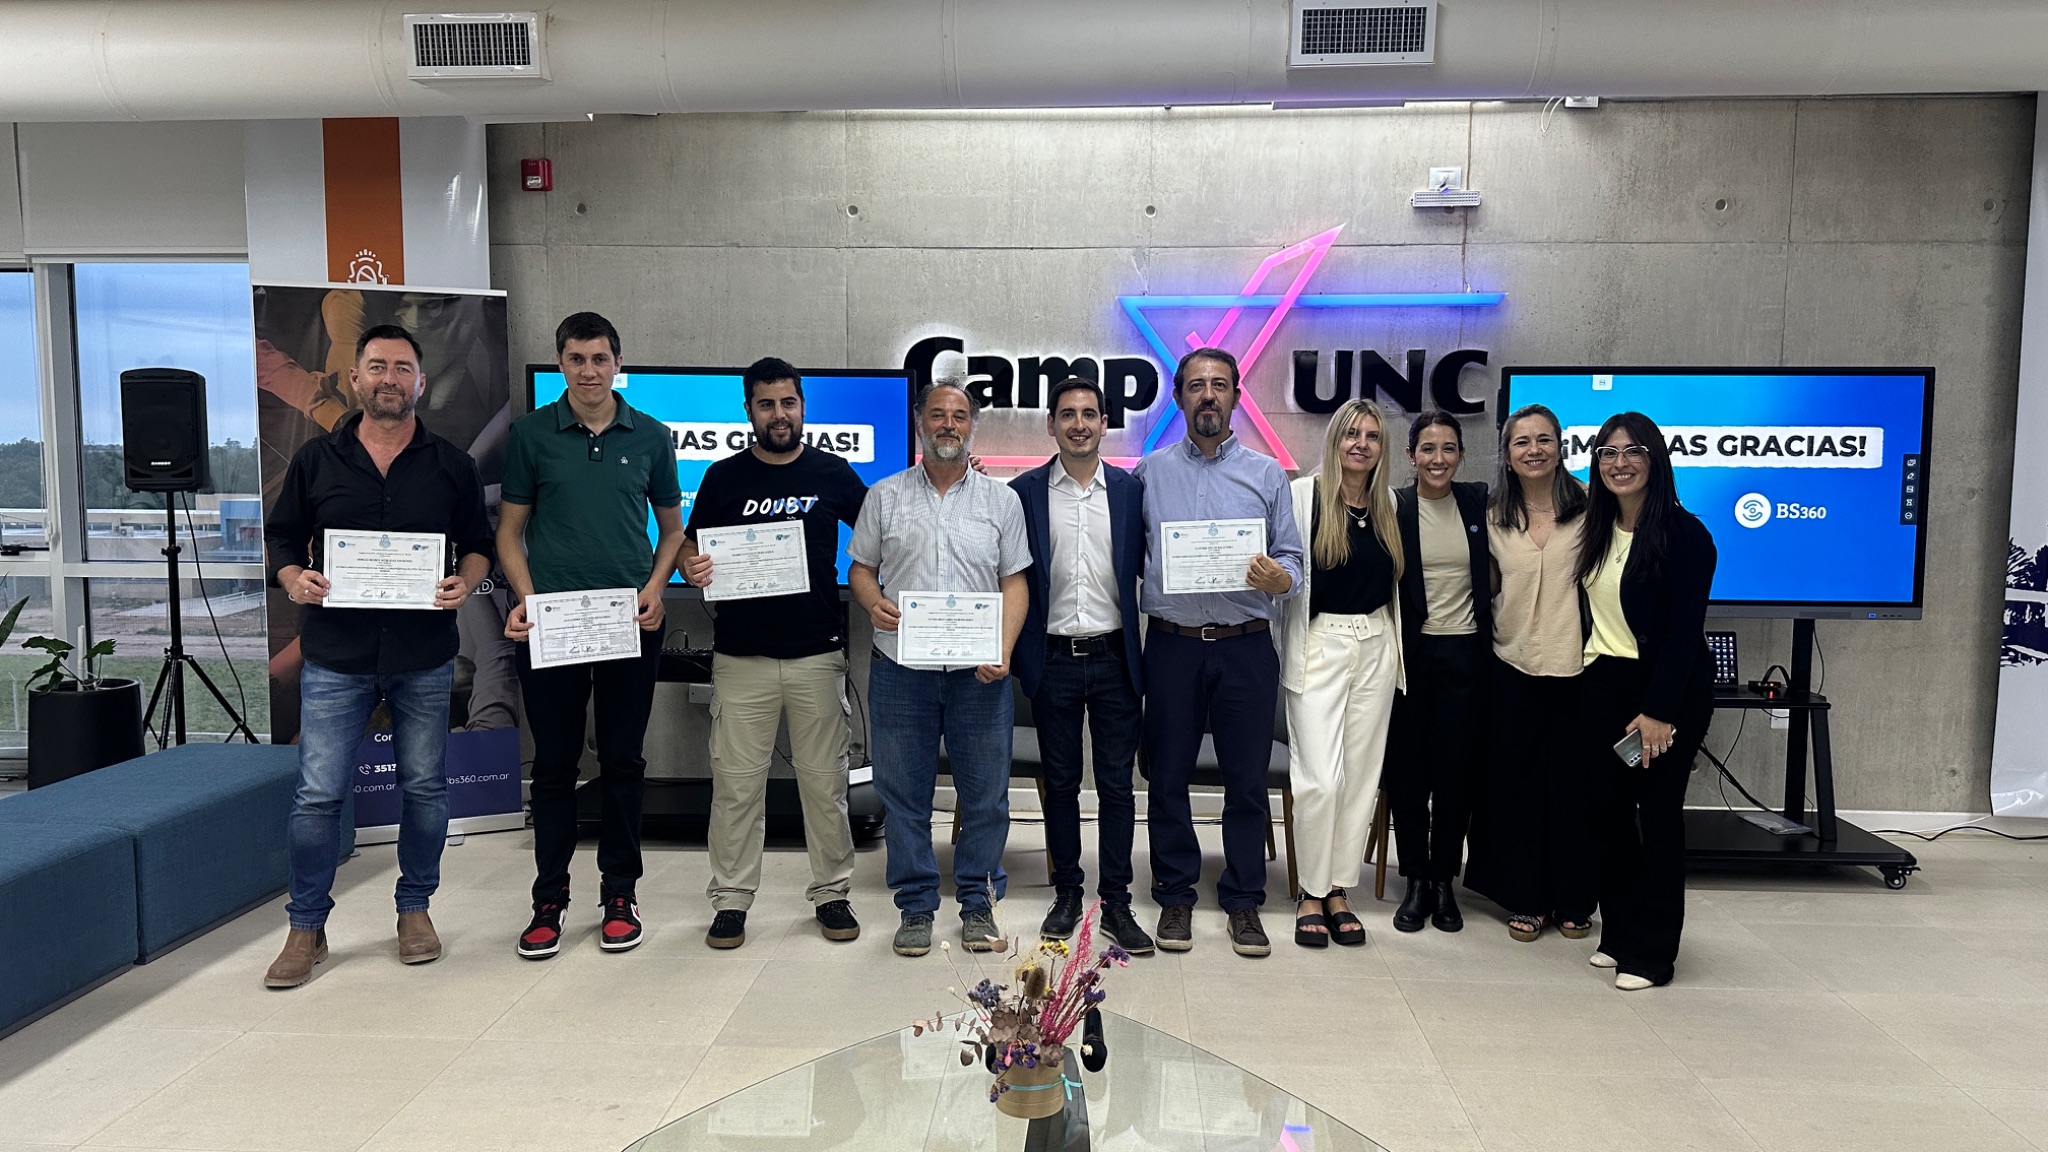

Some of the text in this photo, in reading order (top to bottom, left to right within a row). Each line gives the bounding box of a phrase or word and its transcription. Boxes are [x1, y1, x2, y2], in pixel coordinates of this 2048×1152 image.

[1293, 350, 1489, 415] UNC
[1717, 434, 1867, 458] GRACIAS!
[742, 495, 819, 517] DOUBT
[1775, 502, 1827, 520] BS360
[353, 783, 397, 793] 0.com.ar
